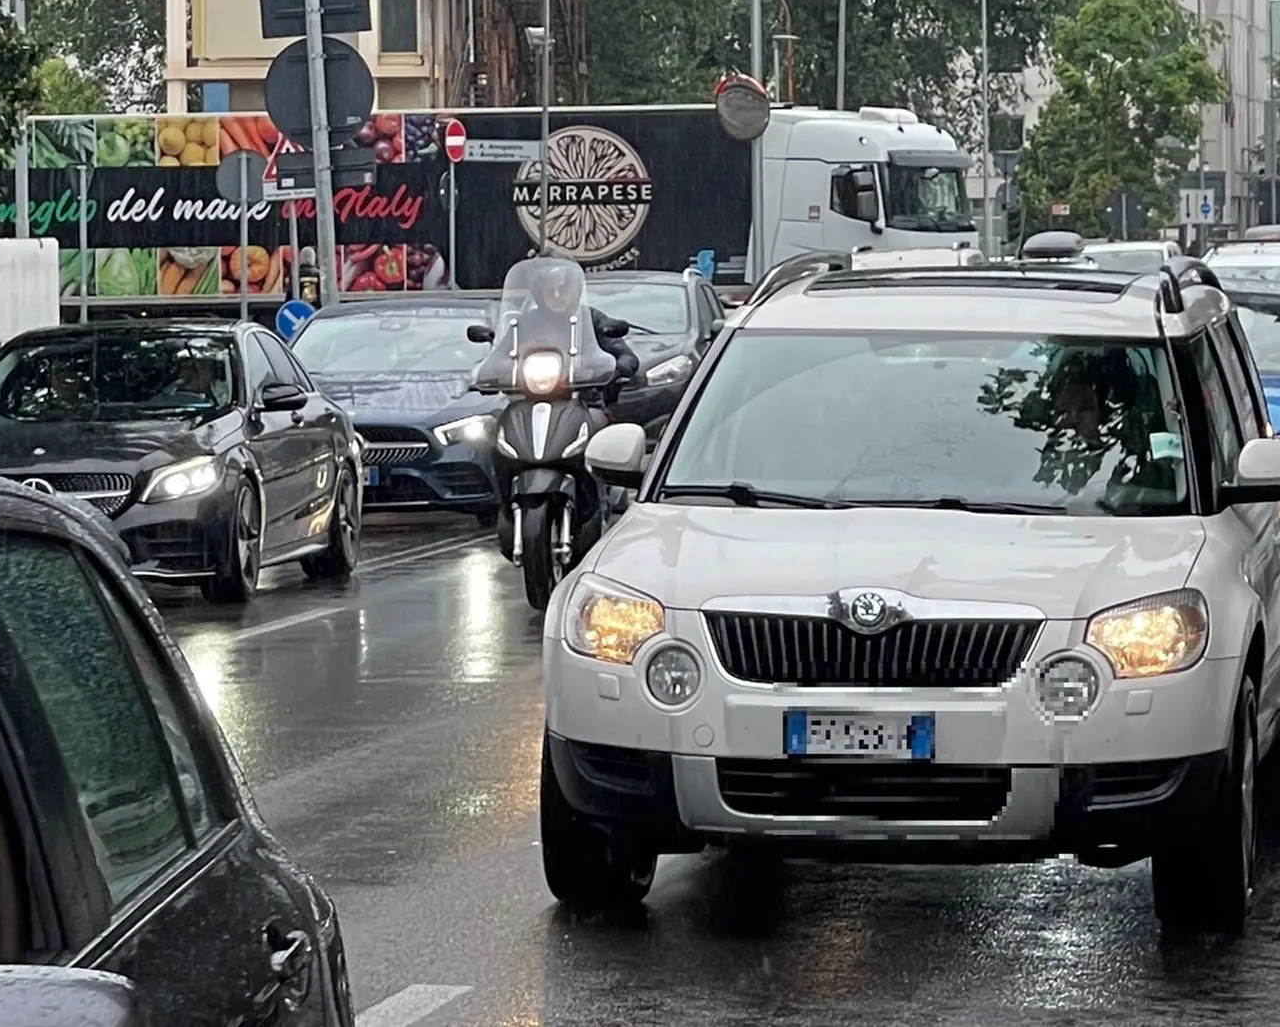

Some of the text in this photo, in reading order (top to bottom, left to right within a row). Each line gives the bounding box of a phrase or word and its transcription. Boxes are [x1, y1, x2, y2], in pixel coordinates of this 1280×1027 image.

[106, 186, 166, 223] del
[333, 184, 424, 230] Italy
[512, 183, 653, 202] MARRAPESE
